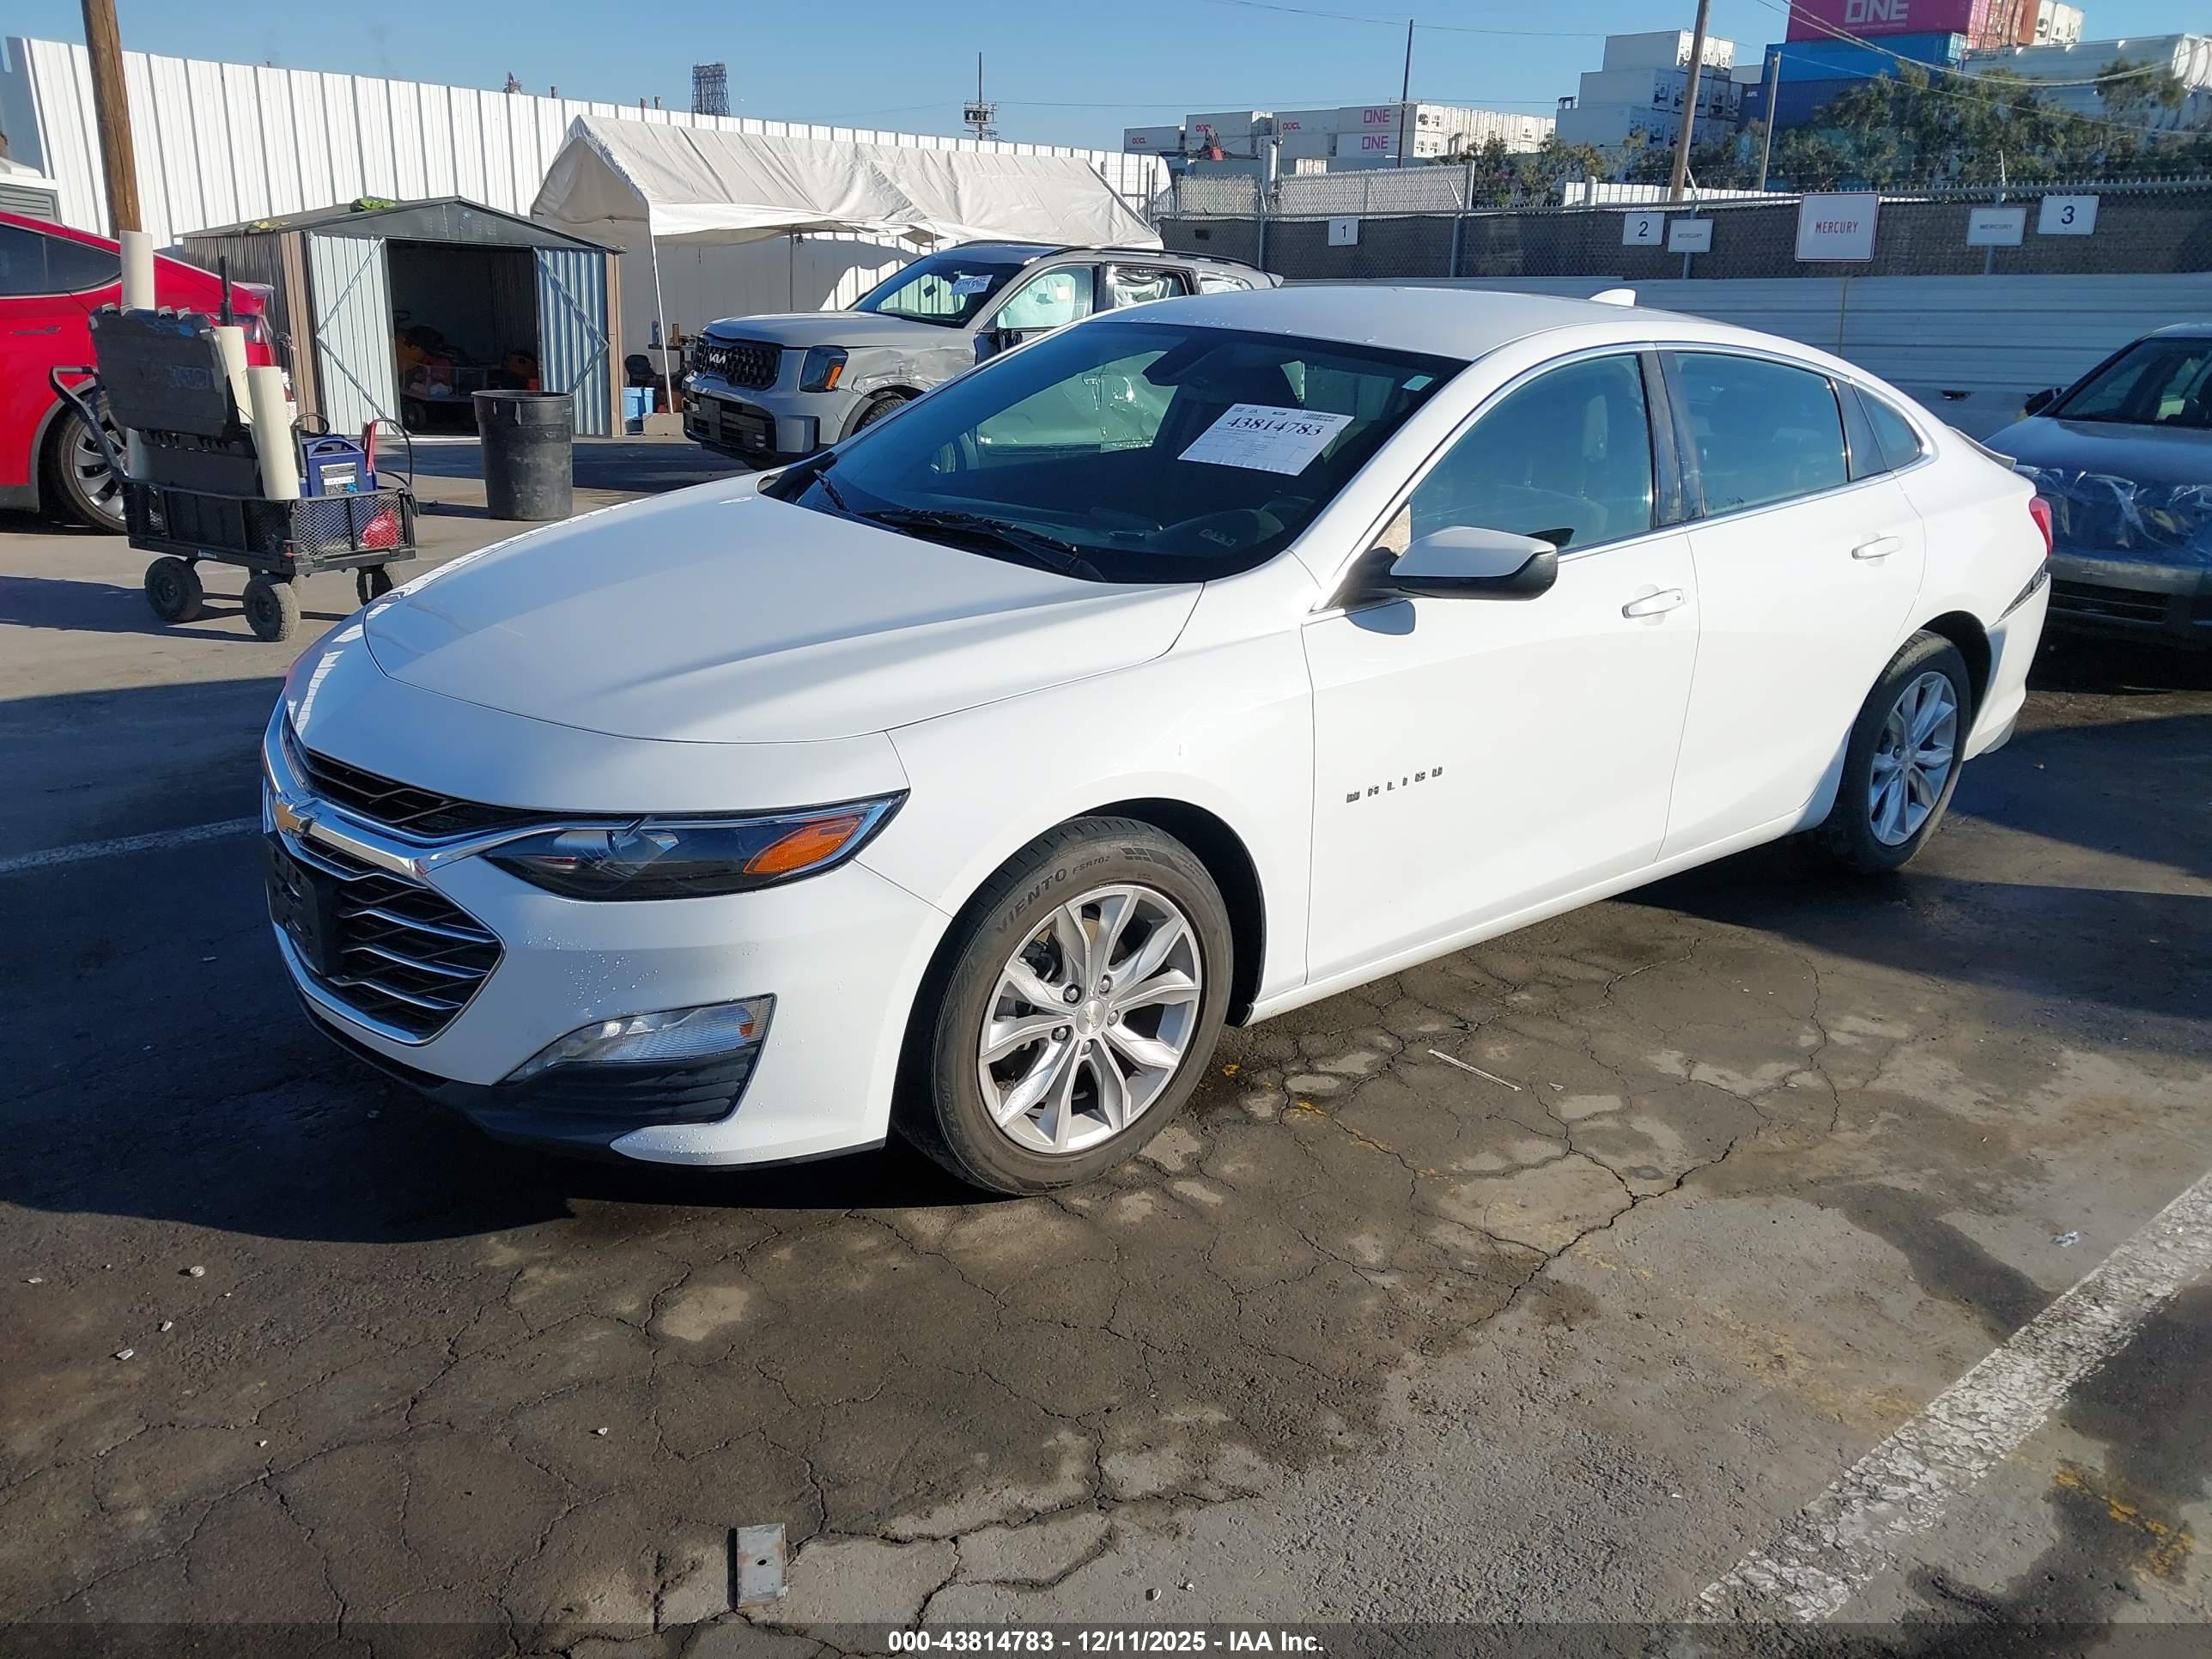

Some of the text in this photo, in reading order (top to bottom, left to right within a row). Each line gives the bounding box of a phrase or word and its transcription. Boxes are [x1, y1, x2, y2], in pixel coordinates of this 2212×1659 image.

[1844, 0, 1910, 23] ONE
[1364, 109, 1391, 124] ONE
[1361, 135, 1389, 150] ONE
[2061, 205, 2075, 225] 3
[1341, 224, 1346, 238] 1
[1638, 221, 1649, 237] 2
[1815, 221, 1858, 234] MERCURY
[1227, 416, 1325, 437] 43814783
[1346, 766, 1443, 803] MALIBU
[996, 868, 1067, 935] VIENTO
